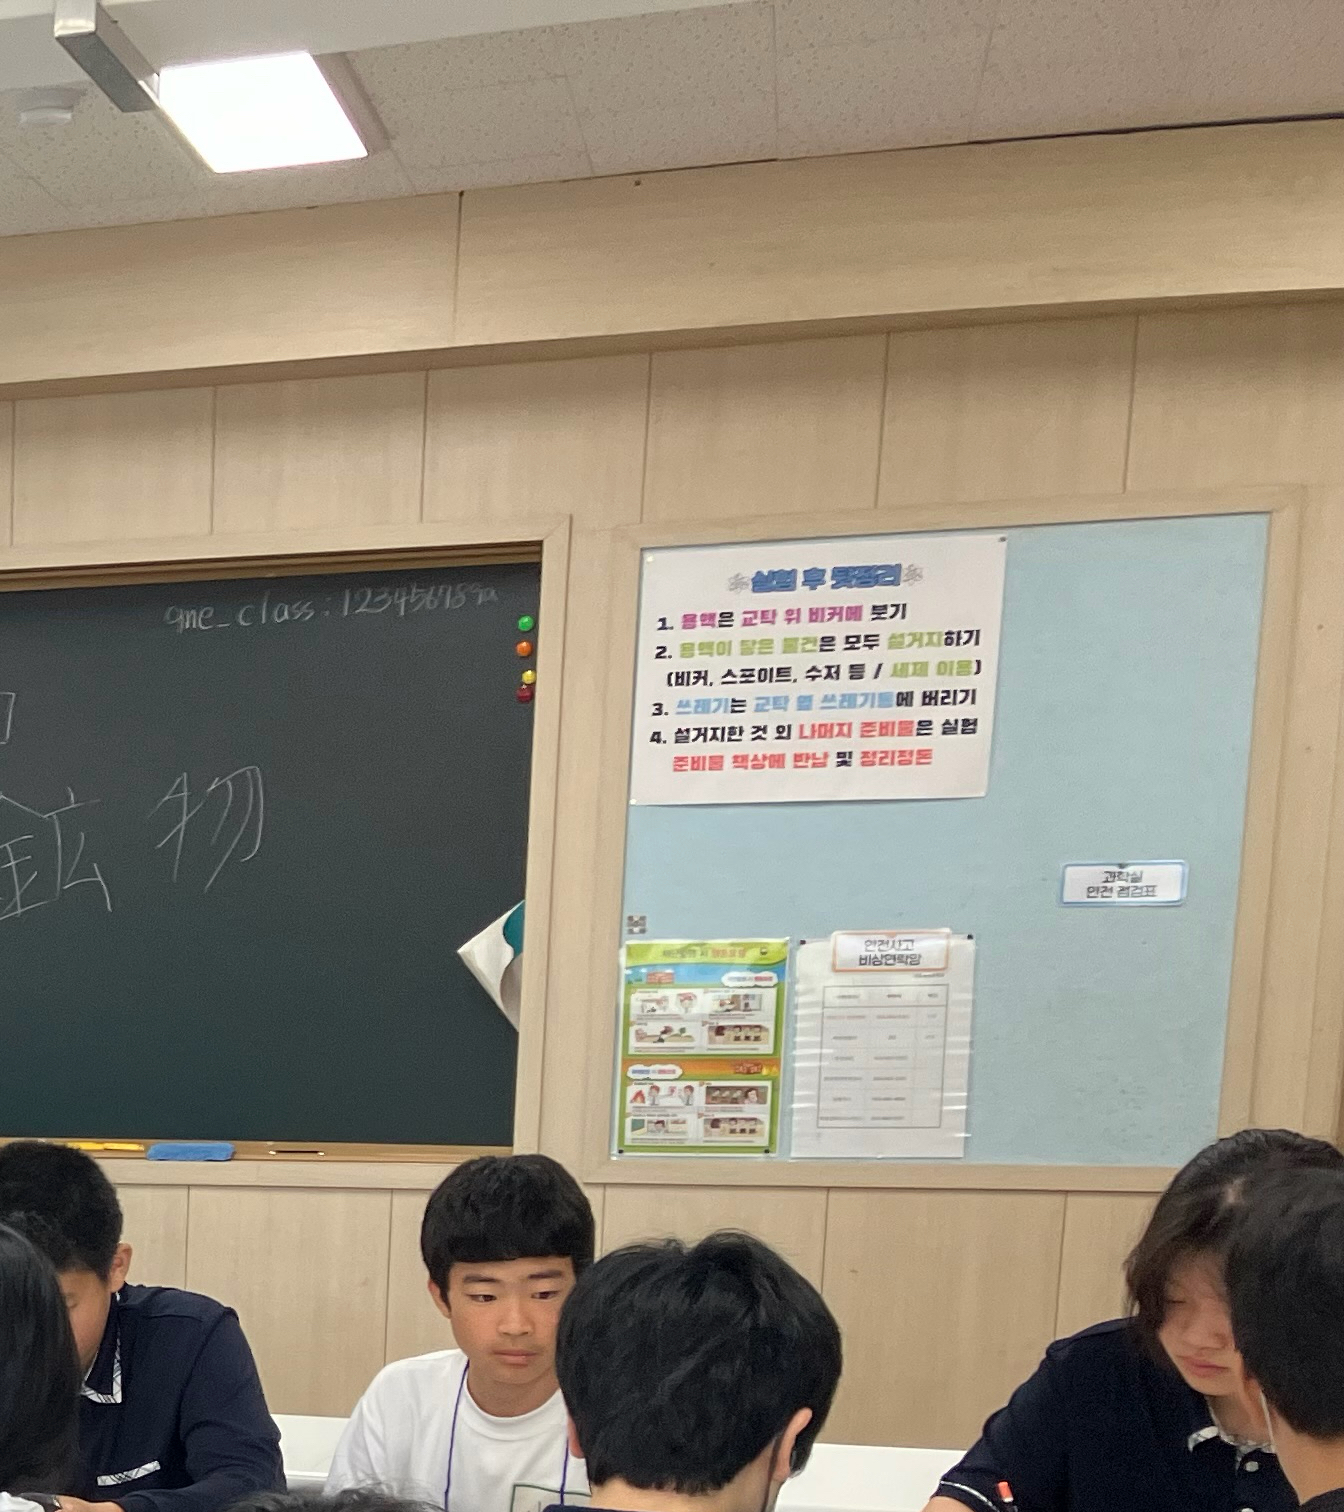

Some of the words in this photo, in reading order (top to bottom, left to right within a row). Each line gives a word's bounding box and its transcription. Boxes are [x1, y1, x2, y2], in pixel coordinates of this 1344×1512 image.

[657, 617, 674, 631] 1.
[681, 611, 734, 630] 용액은
[741, 608, 777, 627] 교탁
[784, 607, 801, 625] 위
[809, 604, 863, 623] 비커에
[871, 603, 907, 621] 붓기
[654, 646, 672, 659] 2.
[679, 640, 732, 658] 용액이
[782, 635, 836, 654] 물건은
[843, 633, 880, 651] 모두
[887, 629, 981, 650] 설거지하기
[667, 670, 713, 687] (비커,
[721, 666, 797, 685] 스포이트,
[805, 664, 840, 682] 수저
[848, 663, 865, 680] 등
[890, 661, 929, 678] 세제
[936, 659, 982, 677] 이용)
[652, 703, 669, 716] 3.
[676, 697, 747, 715] 쓰레기는
[754, 695, 789, 713] 교탁
[820, 691, 914, 710] 쓰레기통에
[921, 688, 977, 707] 버리기
[649, 731, 667, 744] 4.
[674, 726, 744, 744] 설거지한
[751, 725, 767, 741] 것
[775, 724, 792, 740] 외
[799, 722, 853, 740] 나머지
[860, 719, 934, 738] 준비물은
[941, 718, 978, 736] 실험
[673, 755, 724, 772] 준비물
[732, 753, 786, 770] 책상에
[793, 752, 829, 769] 반납
[836, 751, 853, 768] 및
[860, 748, 934, 767] 정리정돈
[1102, 870, 1143, 884] 과학실
[1087, 885, 1113, 899] 안전
[864, 938, 915, 953] 안전사고
